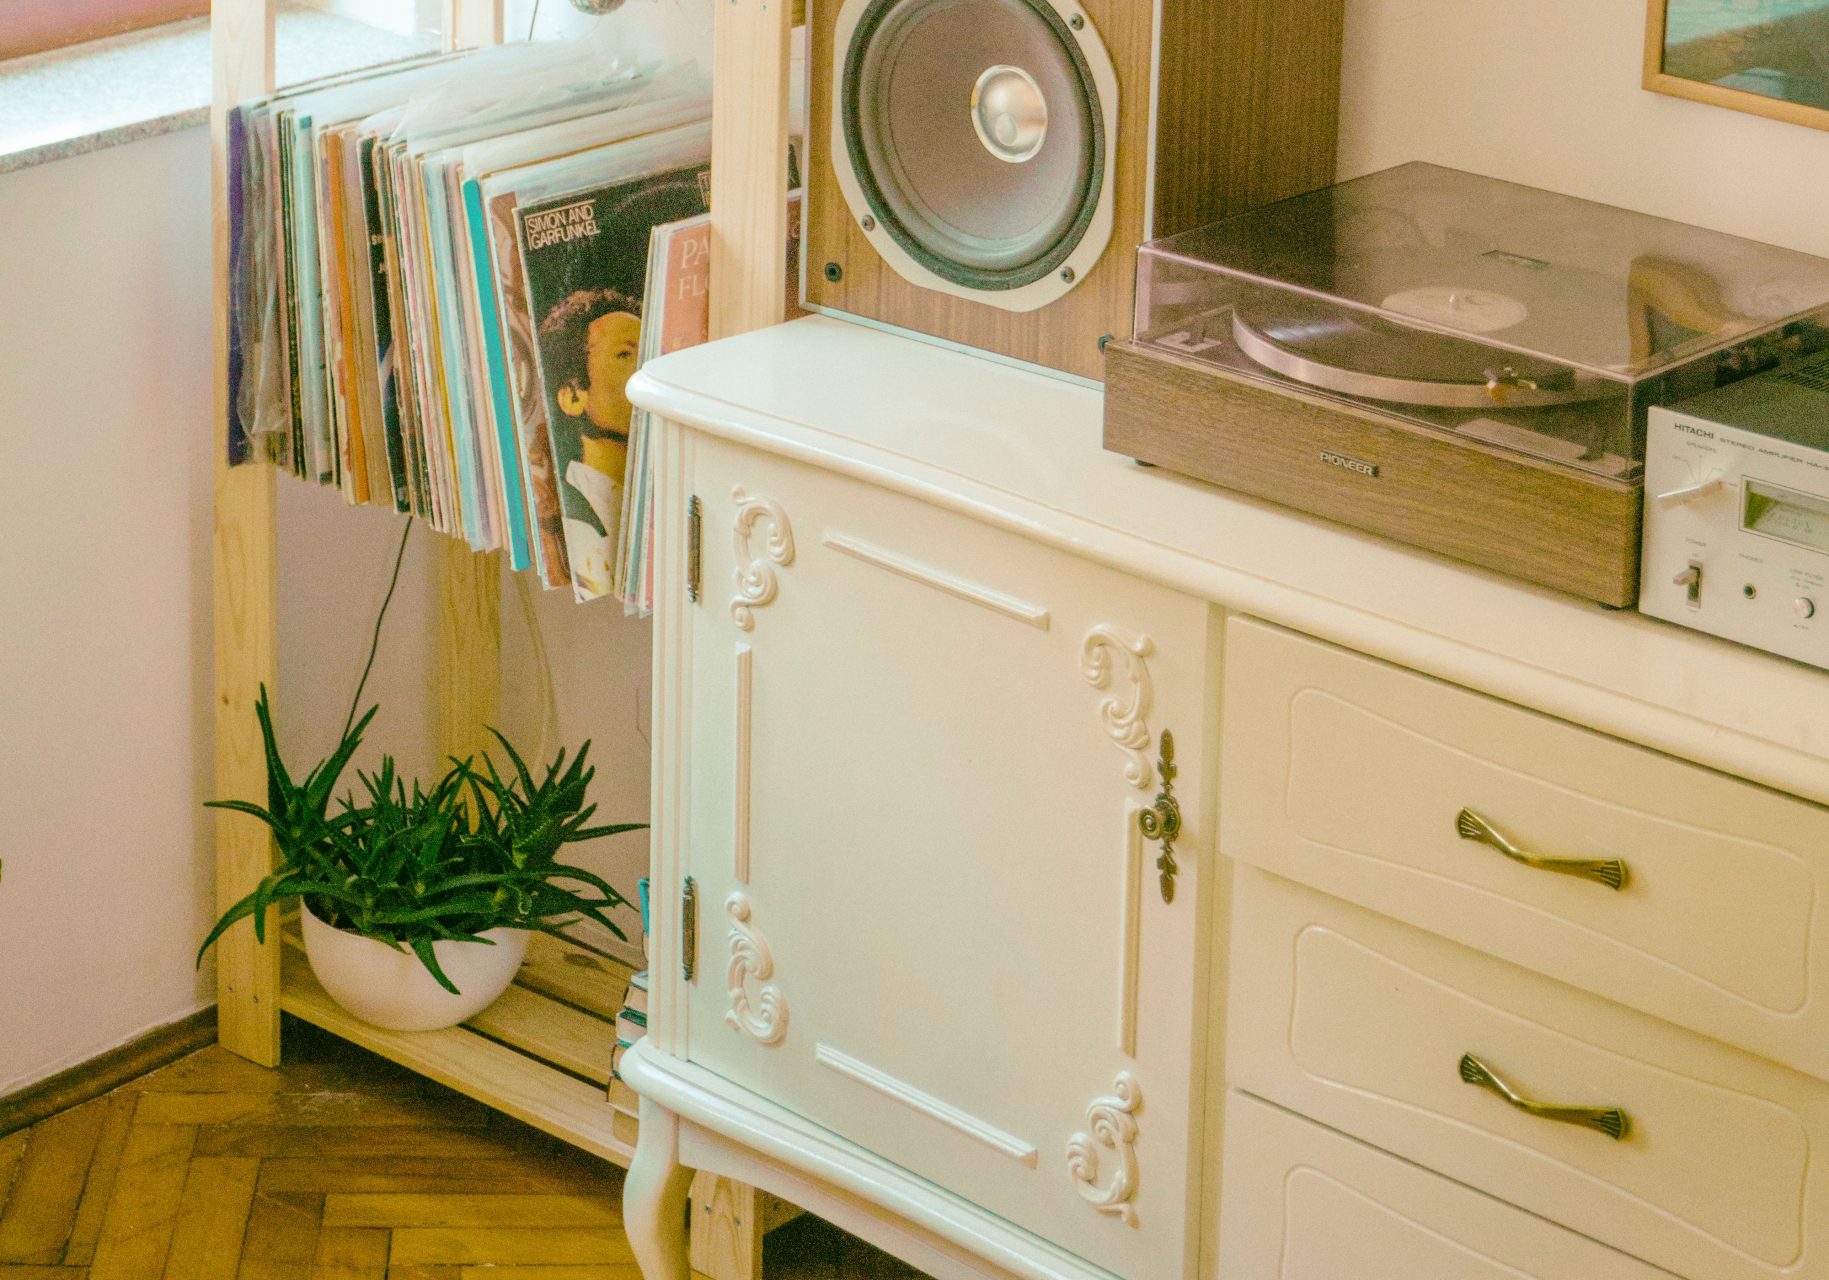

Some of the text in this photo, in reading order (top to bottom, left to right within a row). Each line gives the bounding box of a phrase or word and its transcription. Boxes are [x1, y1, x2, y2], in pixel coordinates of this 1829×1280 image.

[528, 205, 594, 234] SIMON AND
[530, 220, 601, 249] GARFUNKEL
[1674, 422, 1715, 439] HITACHI
[1720, 437, 1755, 451] STEREO
[1758, 448, 1803, 463] AMPLIFIER
[1320, 451, 1373, 476] PIONEER
